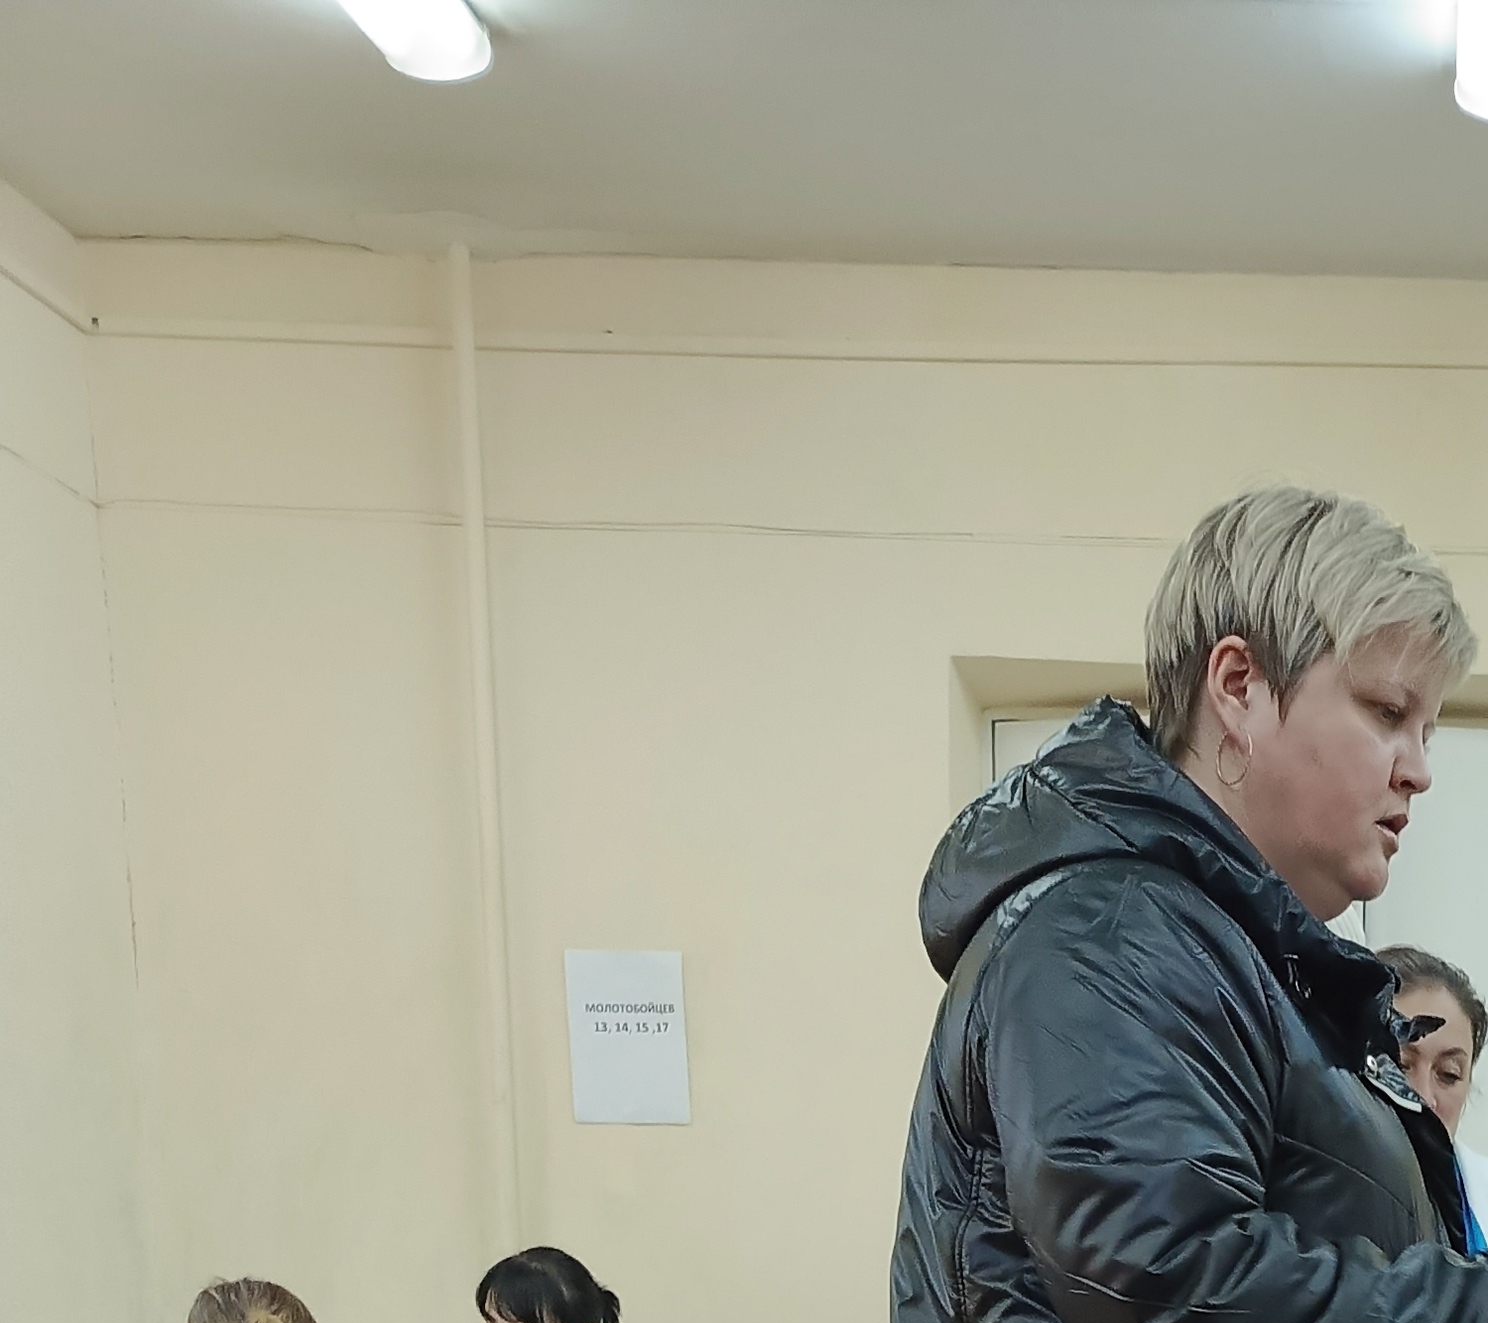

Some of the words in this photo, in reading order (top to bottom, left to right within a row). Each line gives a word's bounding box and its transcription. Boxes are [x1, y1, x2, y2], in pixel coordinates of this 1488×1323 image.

[585, 1002, 675, 1015] МОЛОТОБОЙЦЕВ
[594, 1021, 612, 1034] 13,
[615, 1022, 632, 1035] 14,
[635, 1022, 649, 1033] 15
